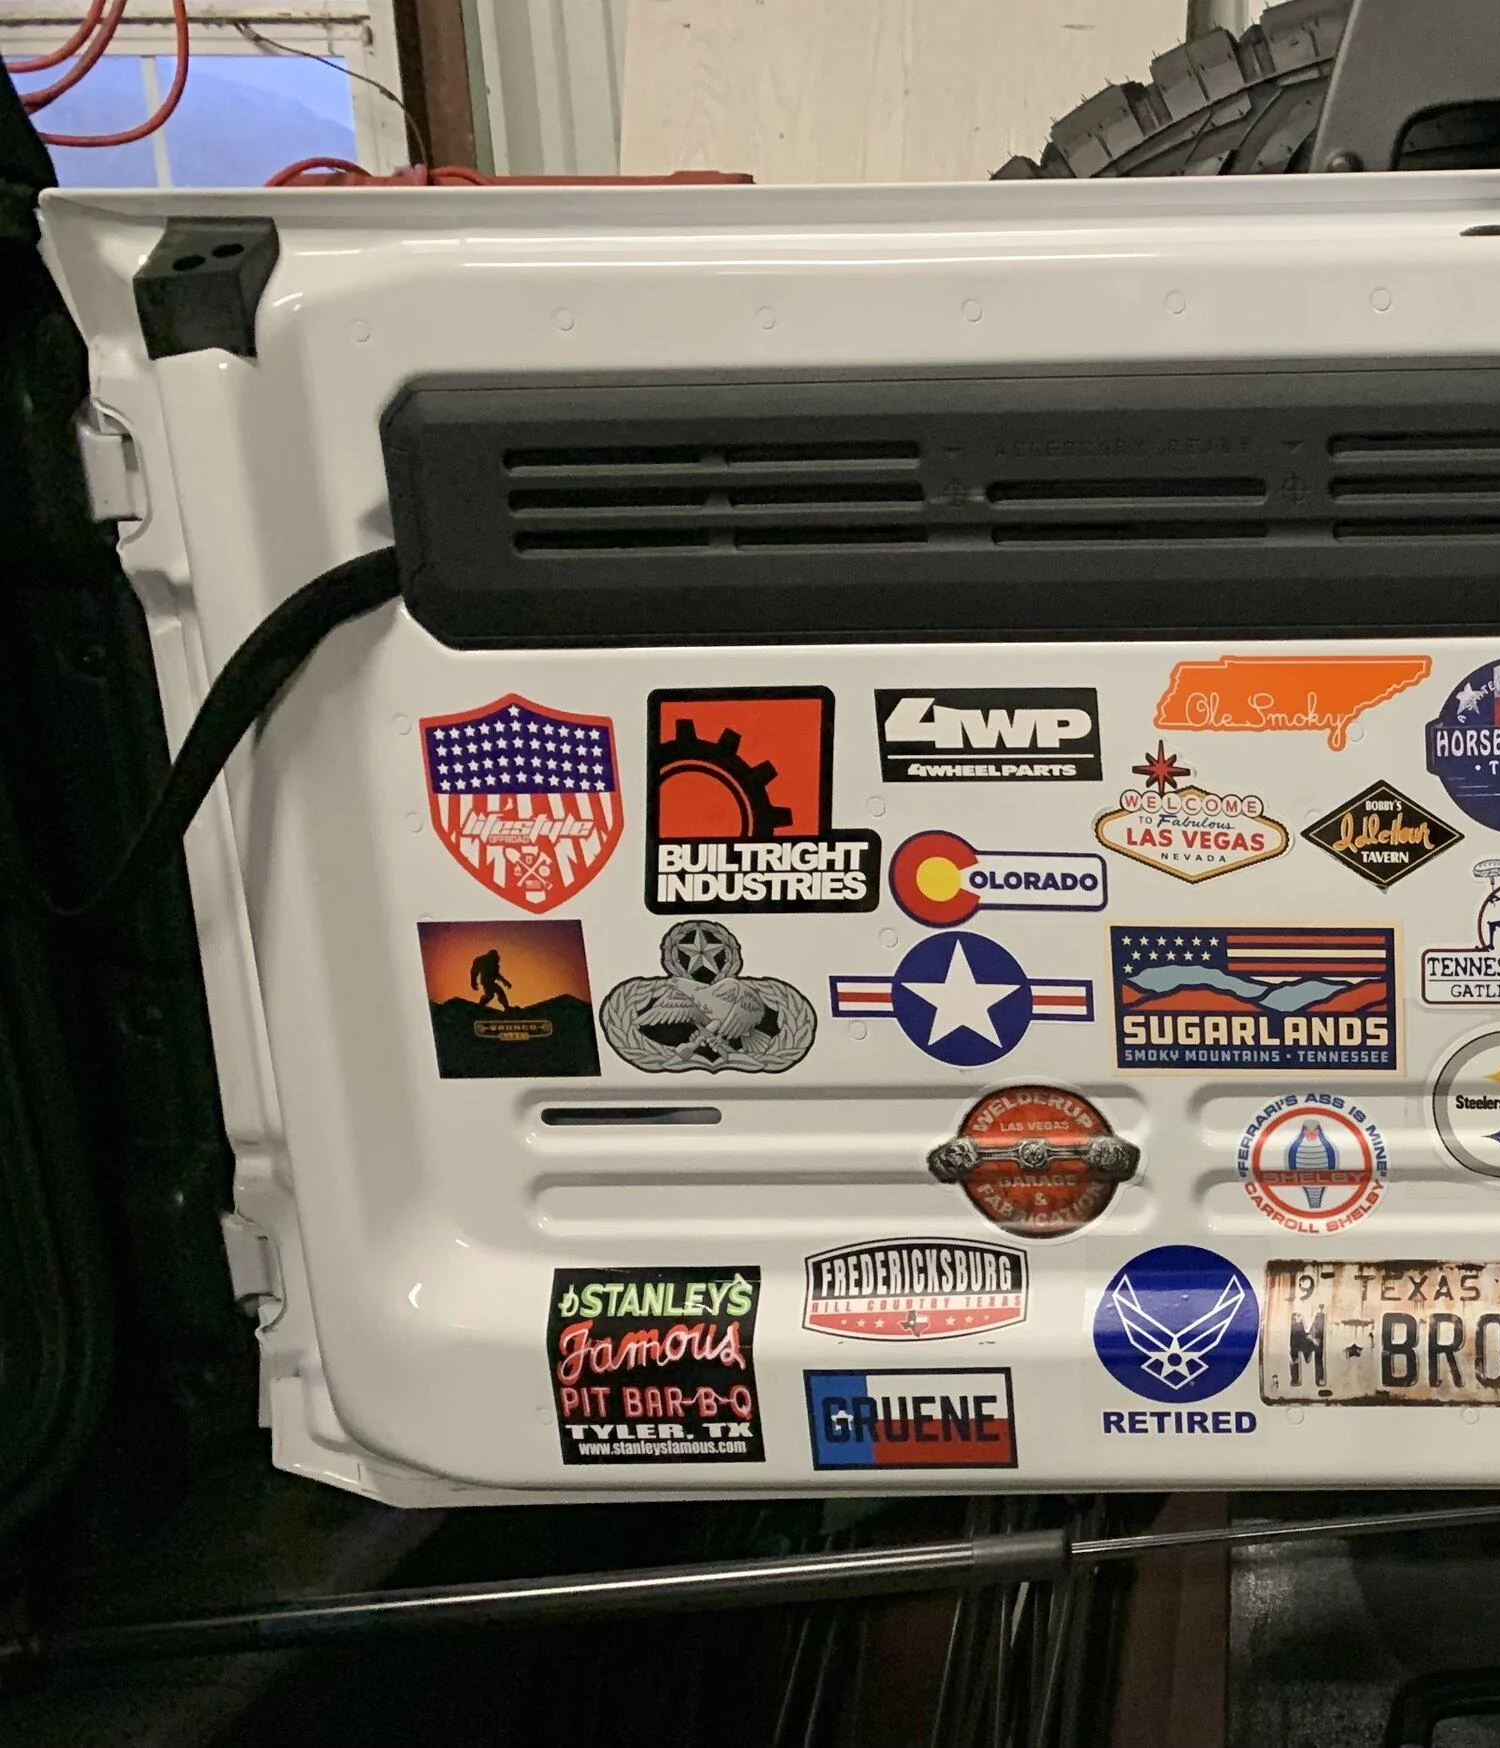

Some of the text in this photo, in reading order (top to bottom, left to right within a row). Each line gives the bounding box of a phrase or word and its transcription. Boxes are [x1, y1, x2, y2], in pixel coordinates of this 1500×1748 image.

[884, 697, 1093, 749] 4WP
[1184, 691, 1347, 748] Ole Smoky
[1123, 793, 1259, 815] WELCOME
[1138, 813, 1236, 831] TO Fabulous
[1126, 827, 1265, 852] LAS VEGAS
[657, 841, 869, 874] BUILTRIGHT
[1160, 852, 1228, 863] NEVADA
[1360, 851, 1410, 864] TAVERN
[657, 871, 868, 902] INDUSTRIES
[1122, 1015, 1390, 1047] SUGARLANDS
[1123, 1049, 1390, 1064] SMOKY MOUNTAINS TENNESSEE
[972, 1090, 1094, 1133] WELDERUP
[1304, 1092, 1346, 1110] ASS
[1348, 1106, 1367, 1124] IS
[999, 1120, 1070, 1133] LAS VEGAS
[998, 1173, 1078, 1188] GARAGE
[1263, 1171, 1368, 1185] SHELBY
[1033, 1191, 1048, 1207] &
[1243, 1178, 1386, 1234] CARROLL SHELBY
[820, 1248, 1013, 1298] FREDERICKSBURG
[1354, 1273, 1482, 1302] TEXAS
[811, 1294, 1022, 1314] HILL COUNTRY TEXAS
[556, 1319, 748, 1386] Famous
[560, 1384, 753, 1421] PIT BAR-B-Q
[702, 1422, 754, 1438] TX
[821, 1395, 1001, 1444] GRUENE
[1102, 1411, 1258, 1435] RETIRED
[577, 1440, 748, 1457] www.stanleysfamous.com
